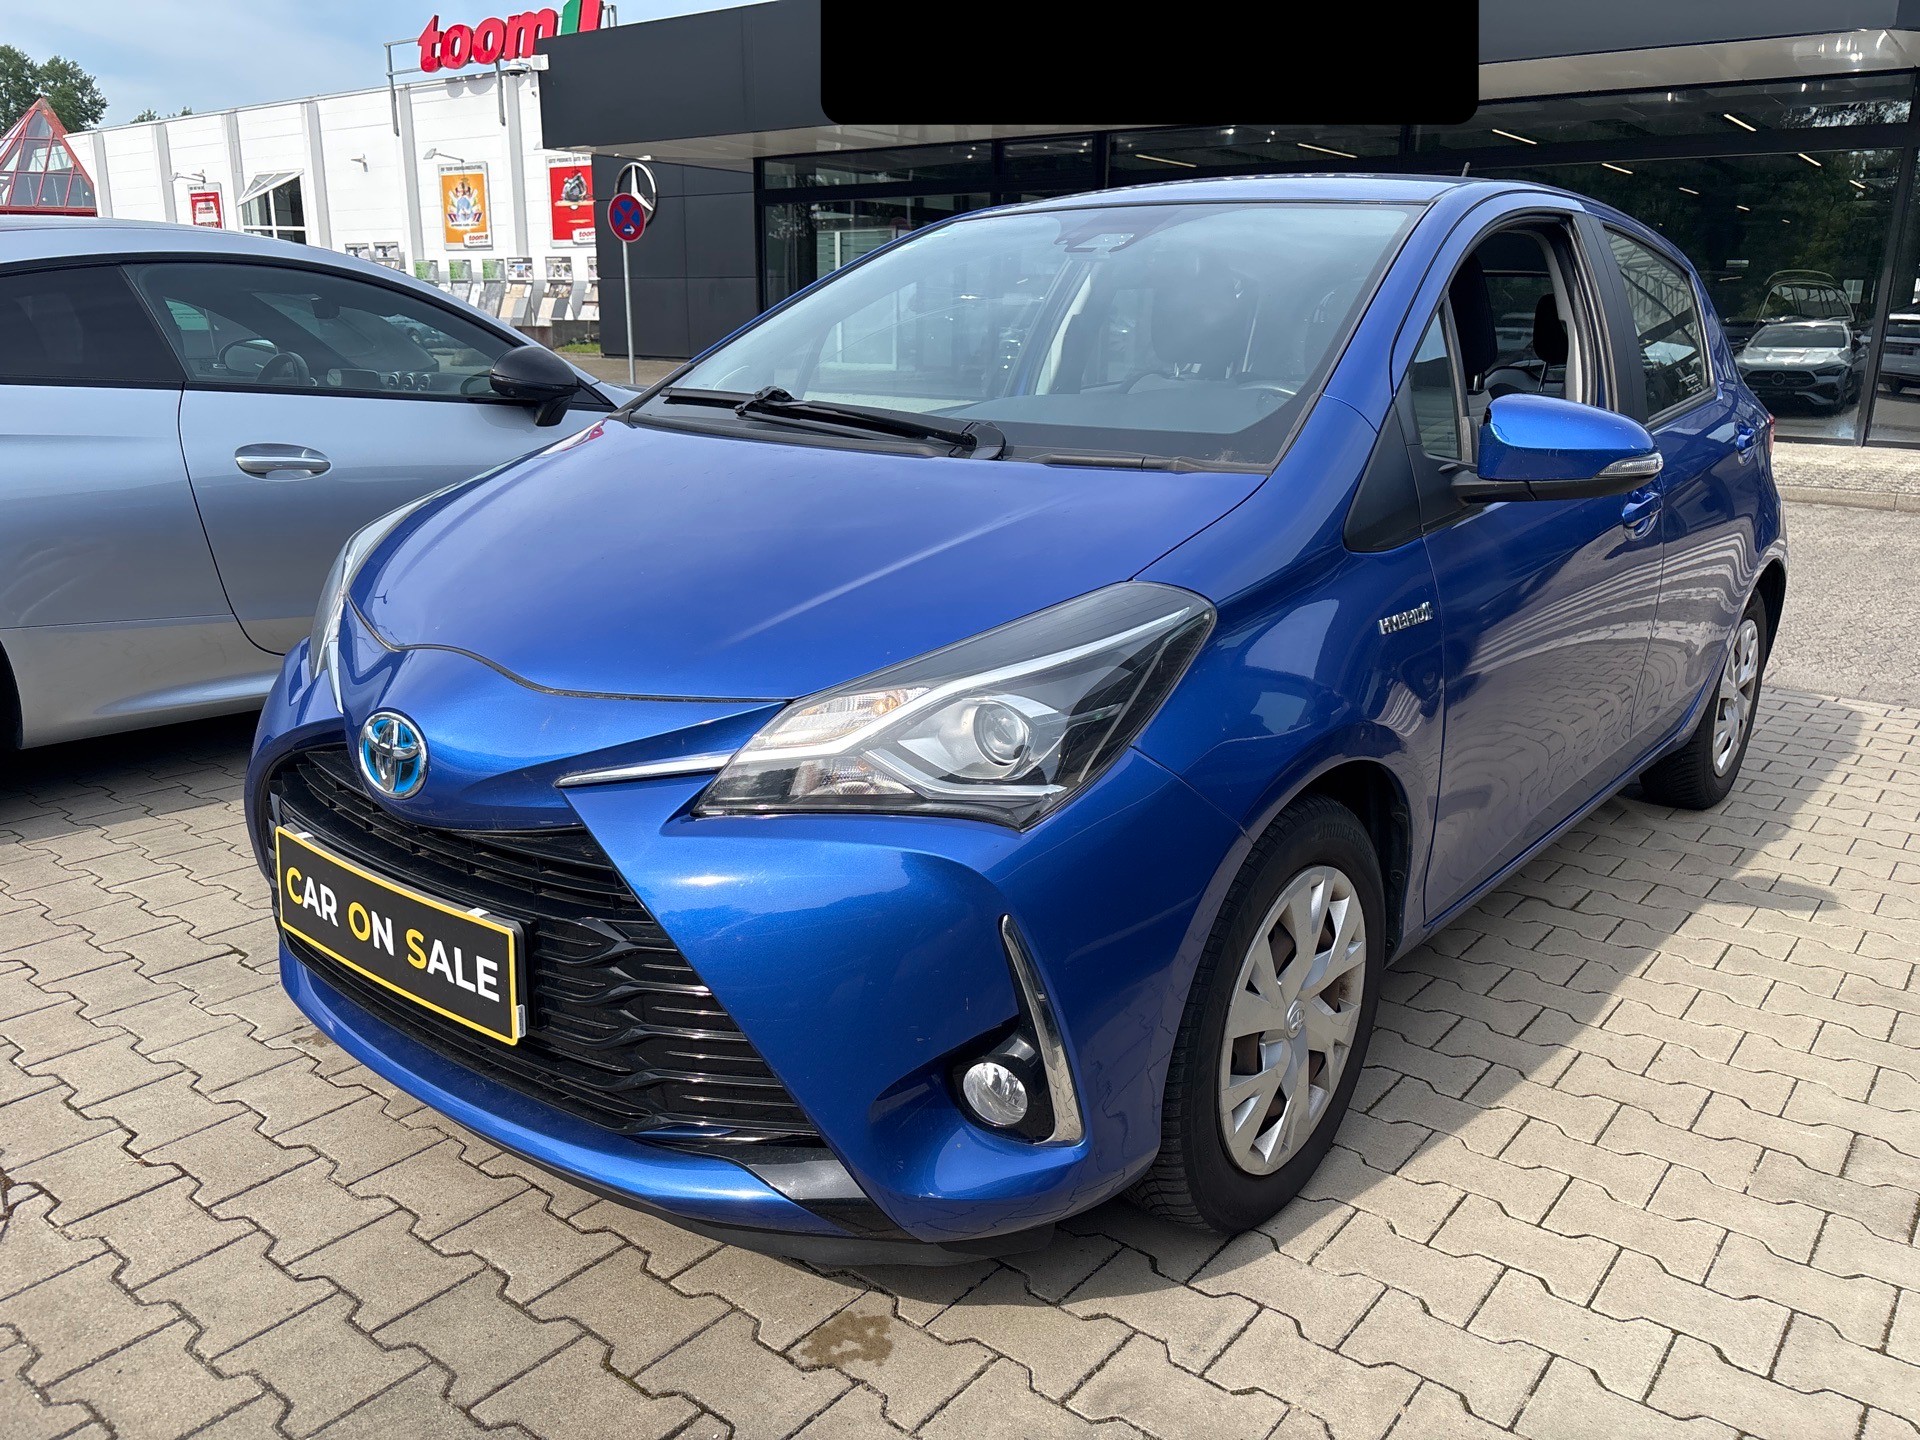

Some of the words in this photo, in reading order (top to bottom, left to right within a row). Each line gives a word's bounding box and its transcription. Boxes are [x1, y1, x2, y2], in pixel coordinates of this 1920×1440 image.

[417, 8, 559, 73] toom
[1378, 604, 1431, 635] HYBRID
[286, 867, 339, 927] CAR
[348, 902, 395, 956] ON
[406, 928, 500, 1002] SALE
